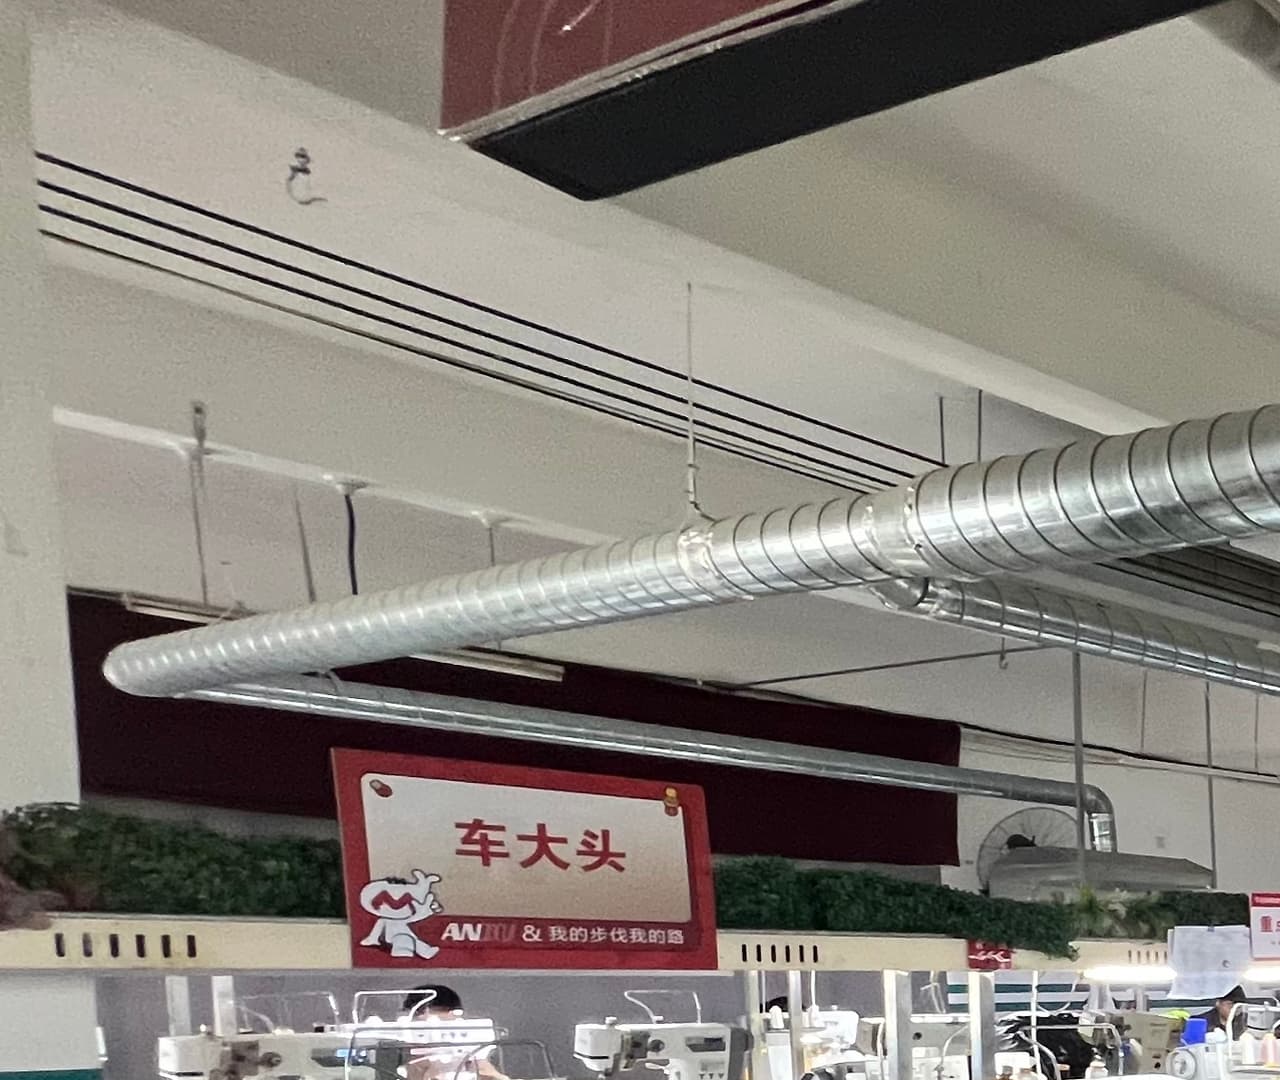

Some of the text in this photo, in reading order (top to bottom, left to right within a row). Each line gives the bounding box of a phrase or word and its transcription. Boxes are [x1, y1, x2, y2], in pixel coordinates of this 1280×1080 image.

[454, 818, 627, 873] 车大头
[522, 924, 543, 943] &
[548, 924, 685, 945] 我的步伐我的路
